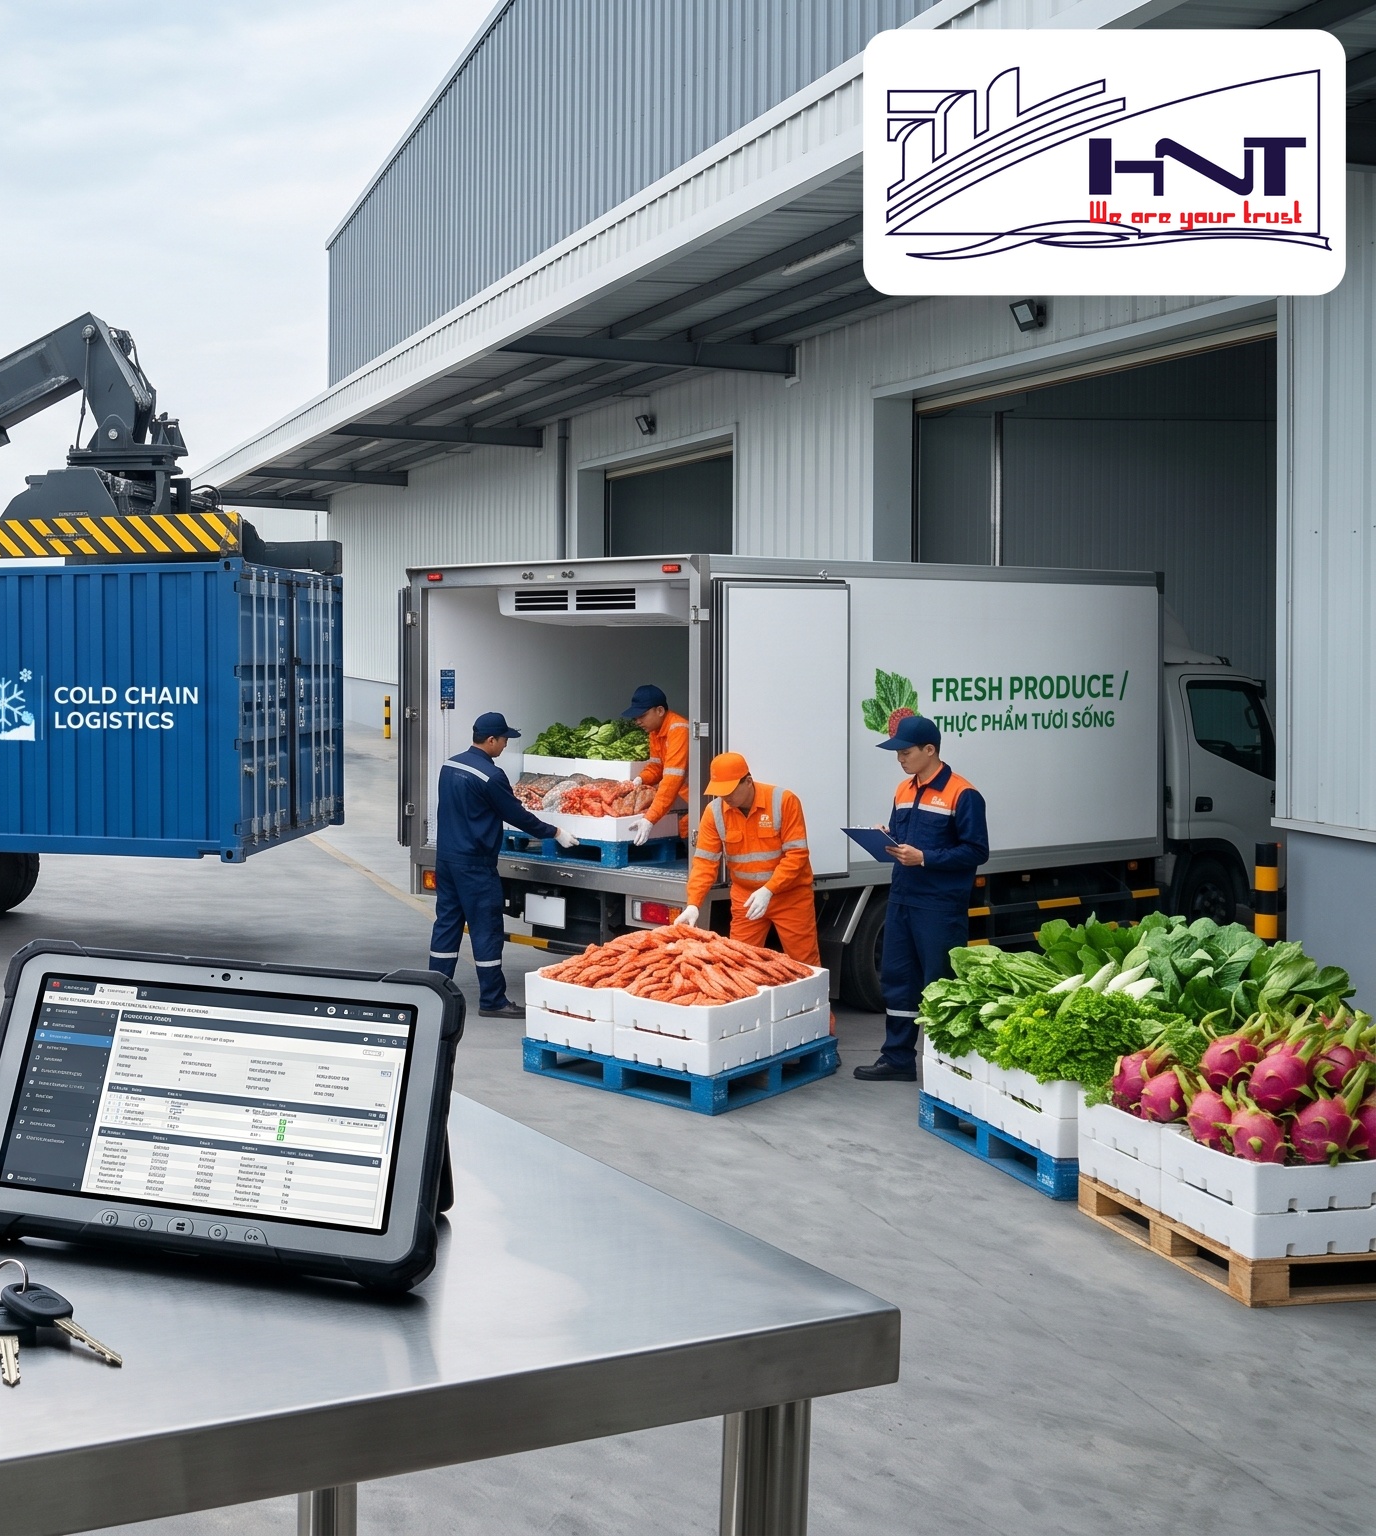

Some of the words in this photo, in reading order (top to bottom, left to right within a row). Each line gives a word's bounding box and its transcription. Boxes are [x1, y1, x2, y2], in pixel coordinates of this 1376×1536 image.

[54, 686, 117, 705] COLD
[125, 686, 199, 705] CHAIN
[932, 676, 1003, 702] FRESH
[1010, 674, 1114, 700] PRODUCE
[1119, 670, 1129, 700] /
[54, 711, 174, 730] LOGISTICS
[934, 712, 977, 737] THỰC
[981, 705, 1028, 731] PHẨM
[1032, 708, 1068, 729] TƯƠI
[1072, 704, 1115, 729] SỐNG
